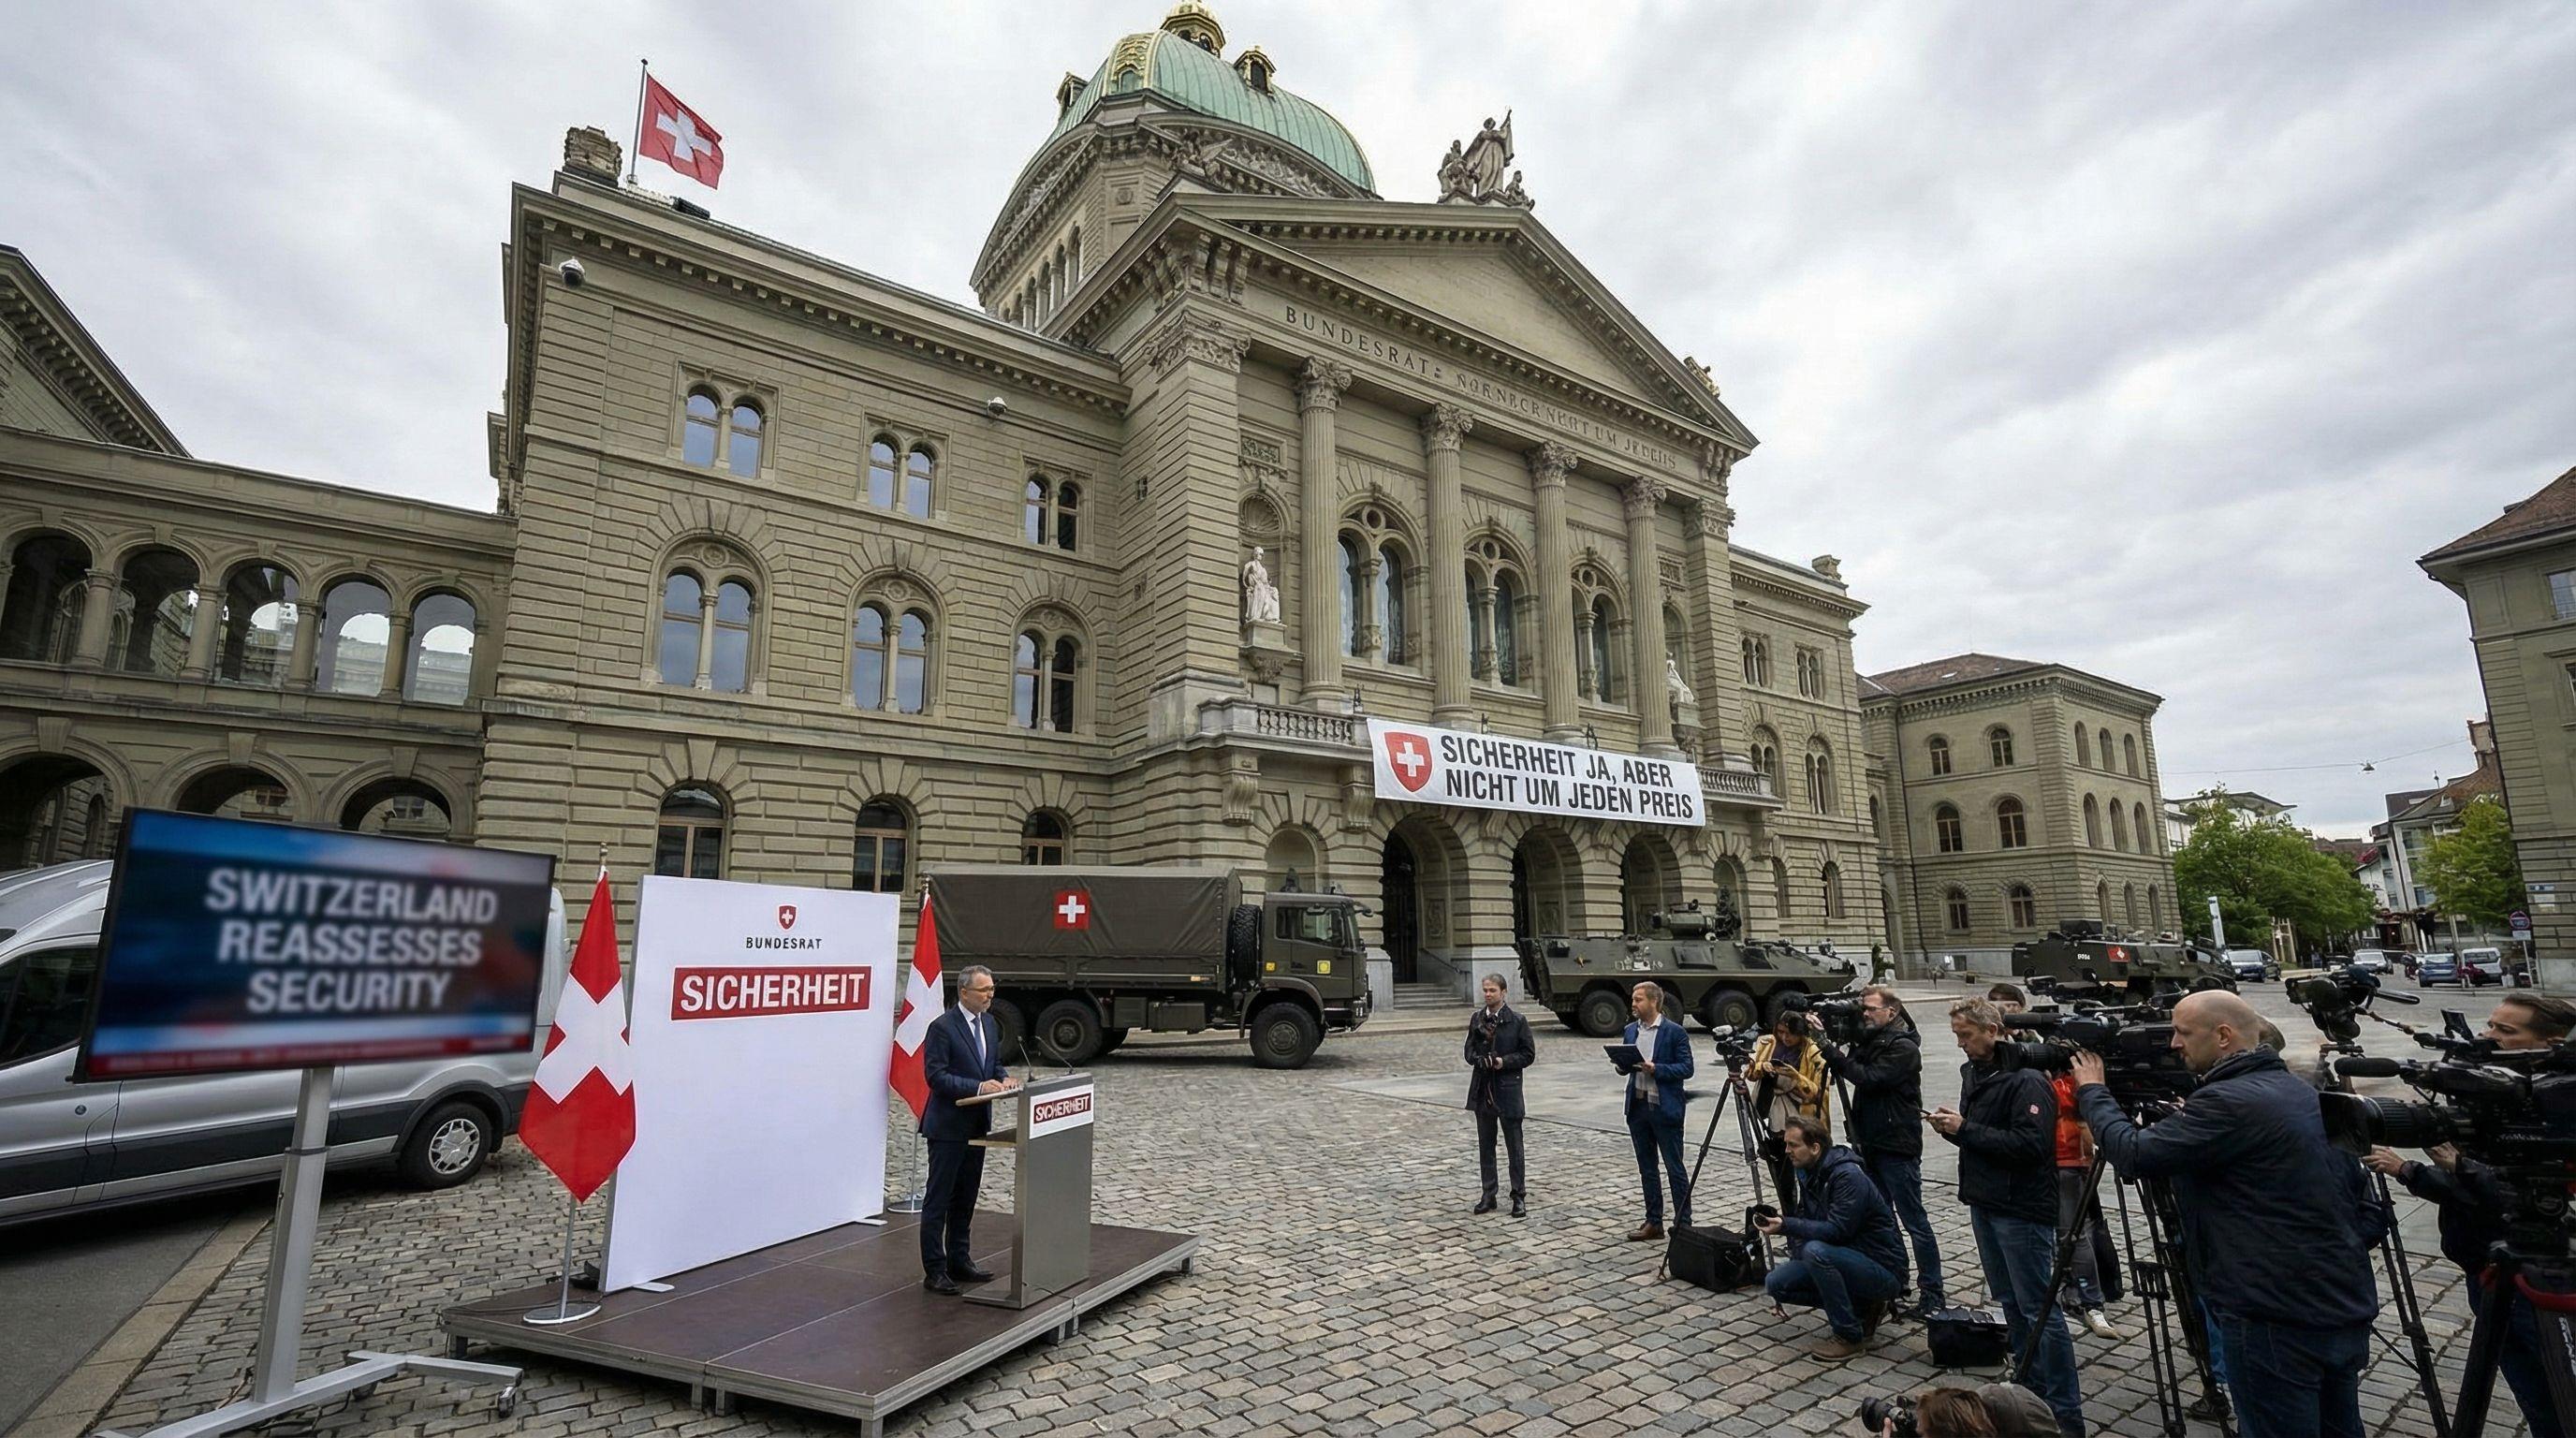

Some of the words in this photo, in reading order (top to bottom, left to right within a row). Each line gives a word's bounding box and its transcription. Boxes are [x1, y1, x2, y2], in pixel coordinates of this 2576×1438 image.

[1441, 735, 1575, 777] SICHERHEIT
[1587, 754, 1617, 785] JA,
[1623, 759, 1674, 788] ABER
[1446, 769, 1517, 802] NICHT
[1526, 777, 1560, 807] UM
[1568, 783, 1632, 814] JEDEN
[1640, 790, 1692, 819] PREIS
[205, 868, 499, 924] SWITZERLAND
[217, 918, 482, 965] REASSESSES
[746, 937, 822, 949] BUNDESRAT
[245, 970, 451, 1013] SECURITY
[681, 974, 865, 1012] SICHERHEIT
